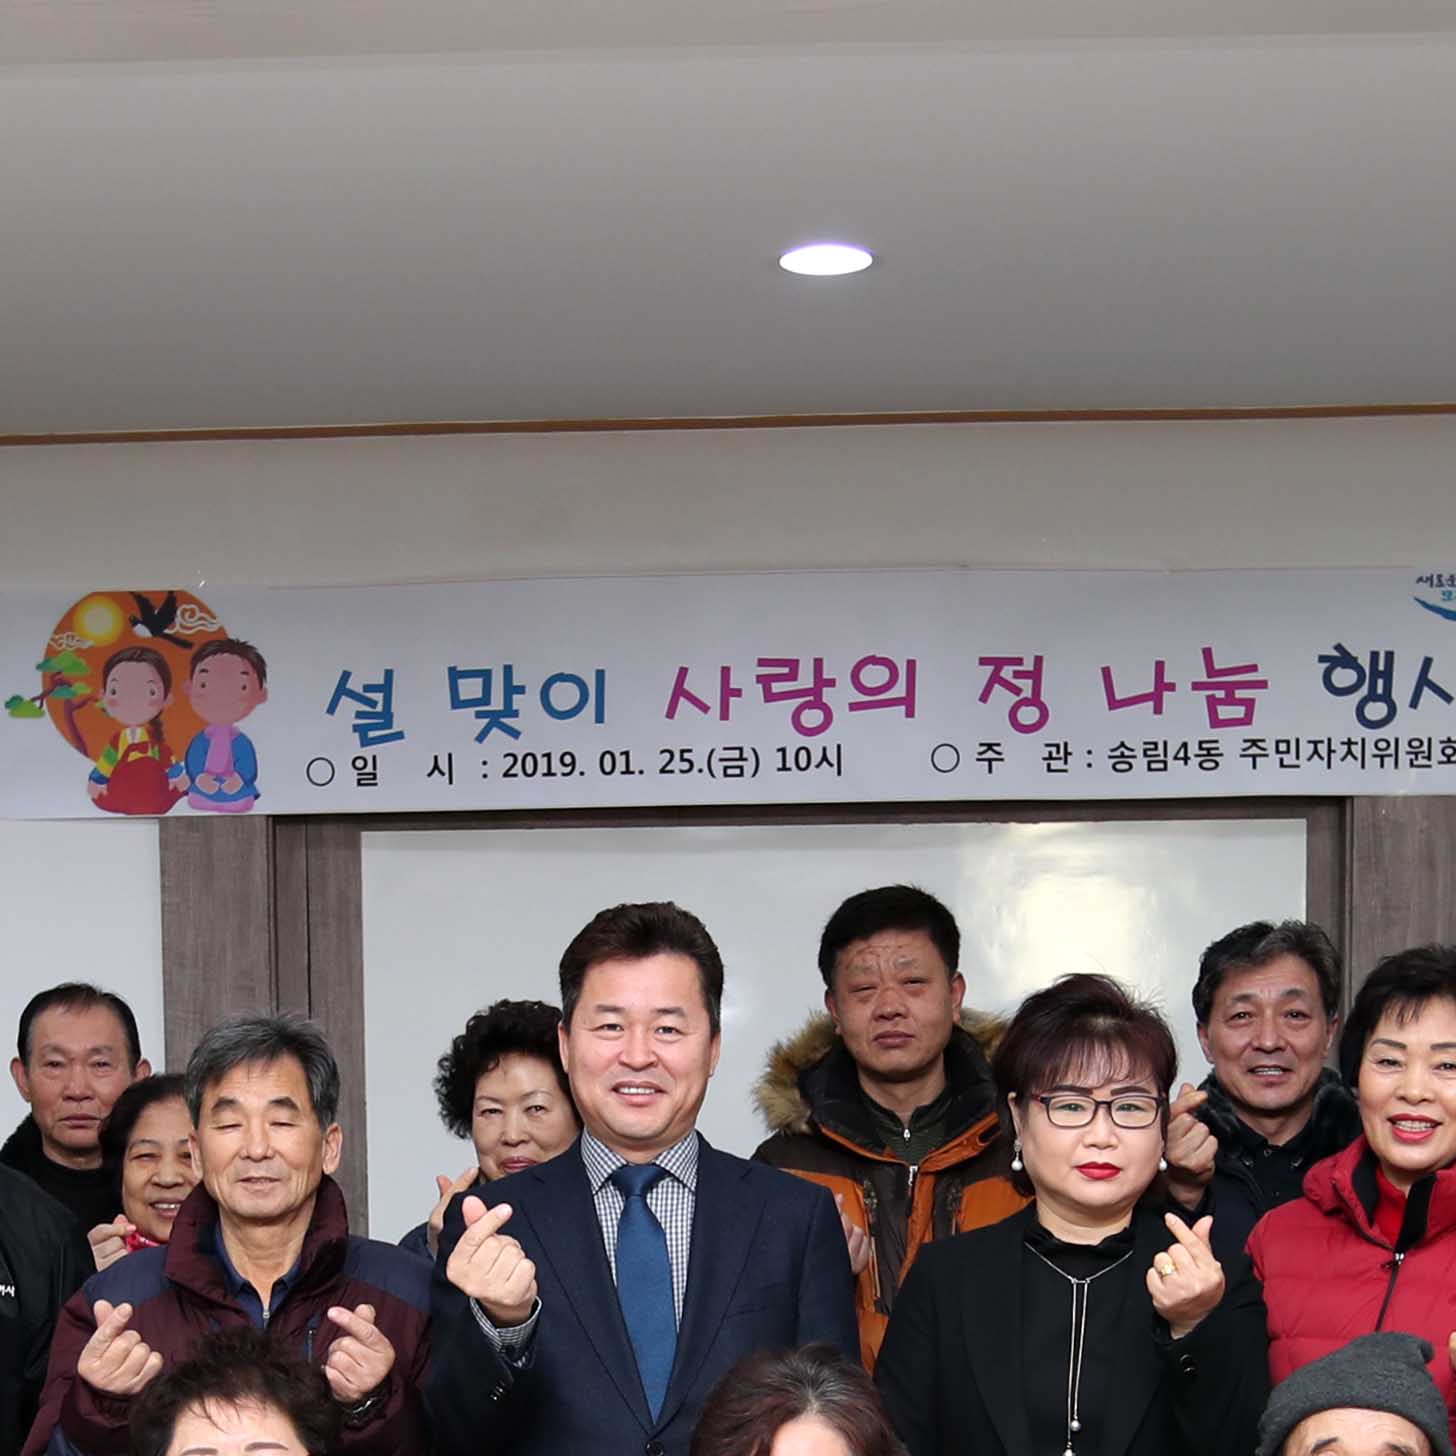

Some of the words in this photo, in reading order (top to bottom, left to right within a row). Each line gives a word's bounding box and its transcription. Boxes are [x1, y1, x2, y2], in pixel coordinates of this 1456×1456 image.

[325, 669, 405, 748] 설
[447, 664, 605, 744] 맞이
[665, 655, 917, 737] 사랑의
[978, 655, 1049, 734] 정
[1100, 647, 1269, 729] 나눔
[350, 754, 379, 787] 일
[426, 752, 454, 786] 시
[501, 751, 585, 778] 2019.
[599, 750, 644, 776] 01.
[658, 746, 761, 779] 25.(금)
[775, 743, 842, 776] 10시
[975, 742, 1005, 774] 주
[1107, 740, 1224, 772] 송림4동
